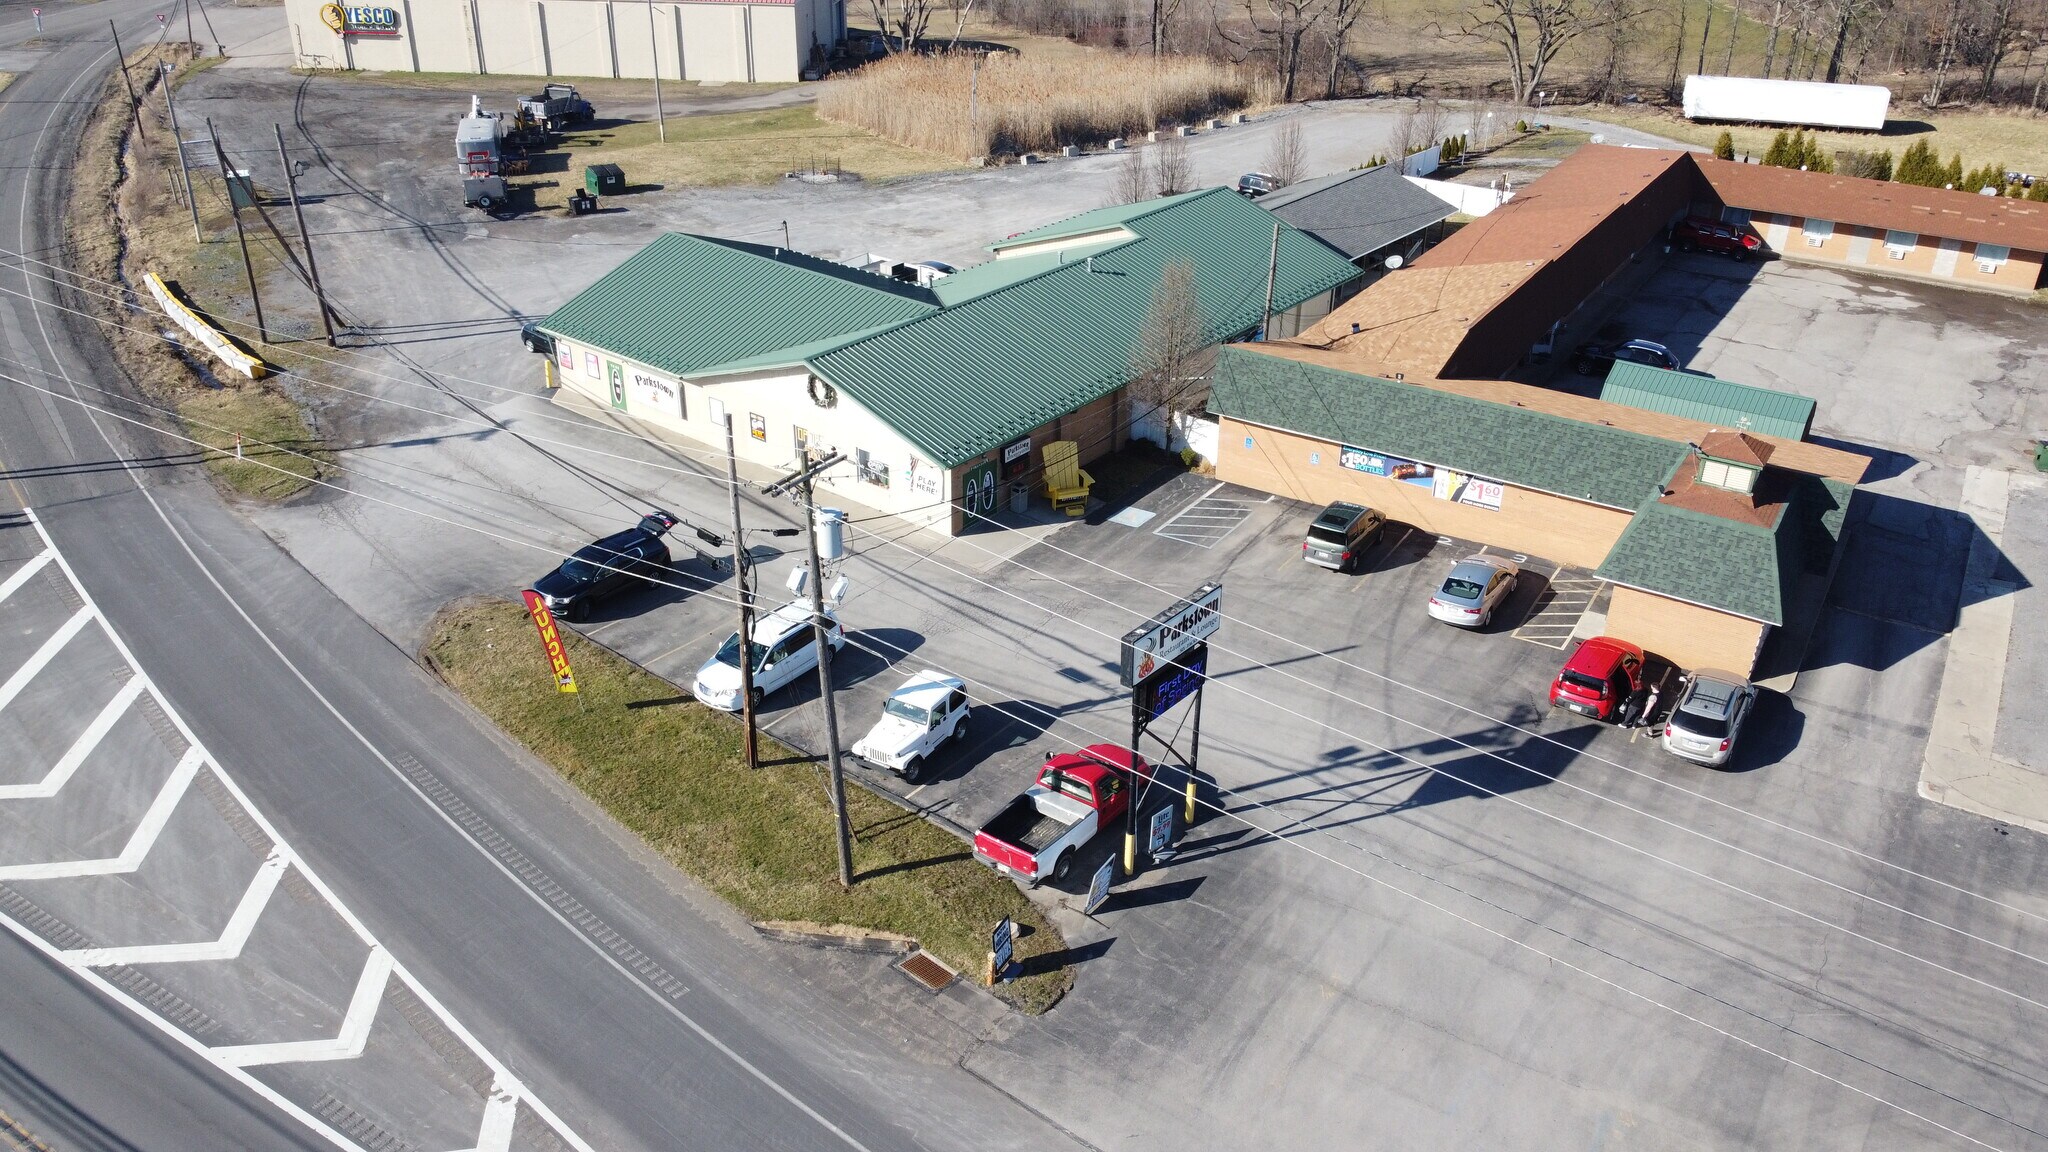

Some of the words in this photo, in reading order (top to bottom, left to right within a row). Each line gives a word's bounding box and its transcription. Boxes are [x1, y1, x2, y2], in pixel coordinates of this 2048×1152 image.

[343, 6, 395, 25] YESCO
[634, 374, 674, 399] Parkstown
[918, 475, 937, 487] PLAY
[1355, 463, 1385, 475] BOTTLES
[1510, 554, 1528, 564] 3
[533, 597, 566, 672] LUNCH
[1159, 598, 1219, 649] Parkstown
[1160, 635, 1190, 658] Restaurant
[1197, 616, 1218, 635] Lounge
[1158, 673, 1182, 697] First
[1184, 660, 1204, 678] Day
